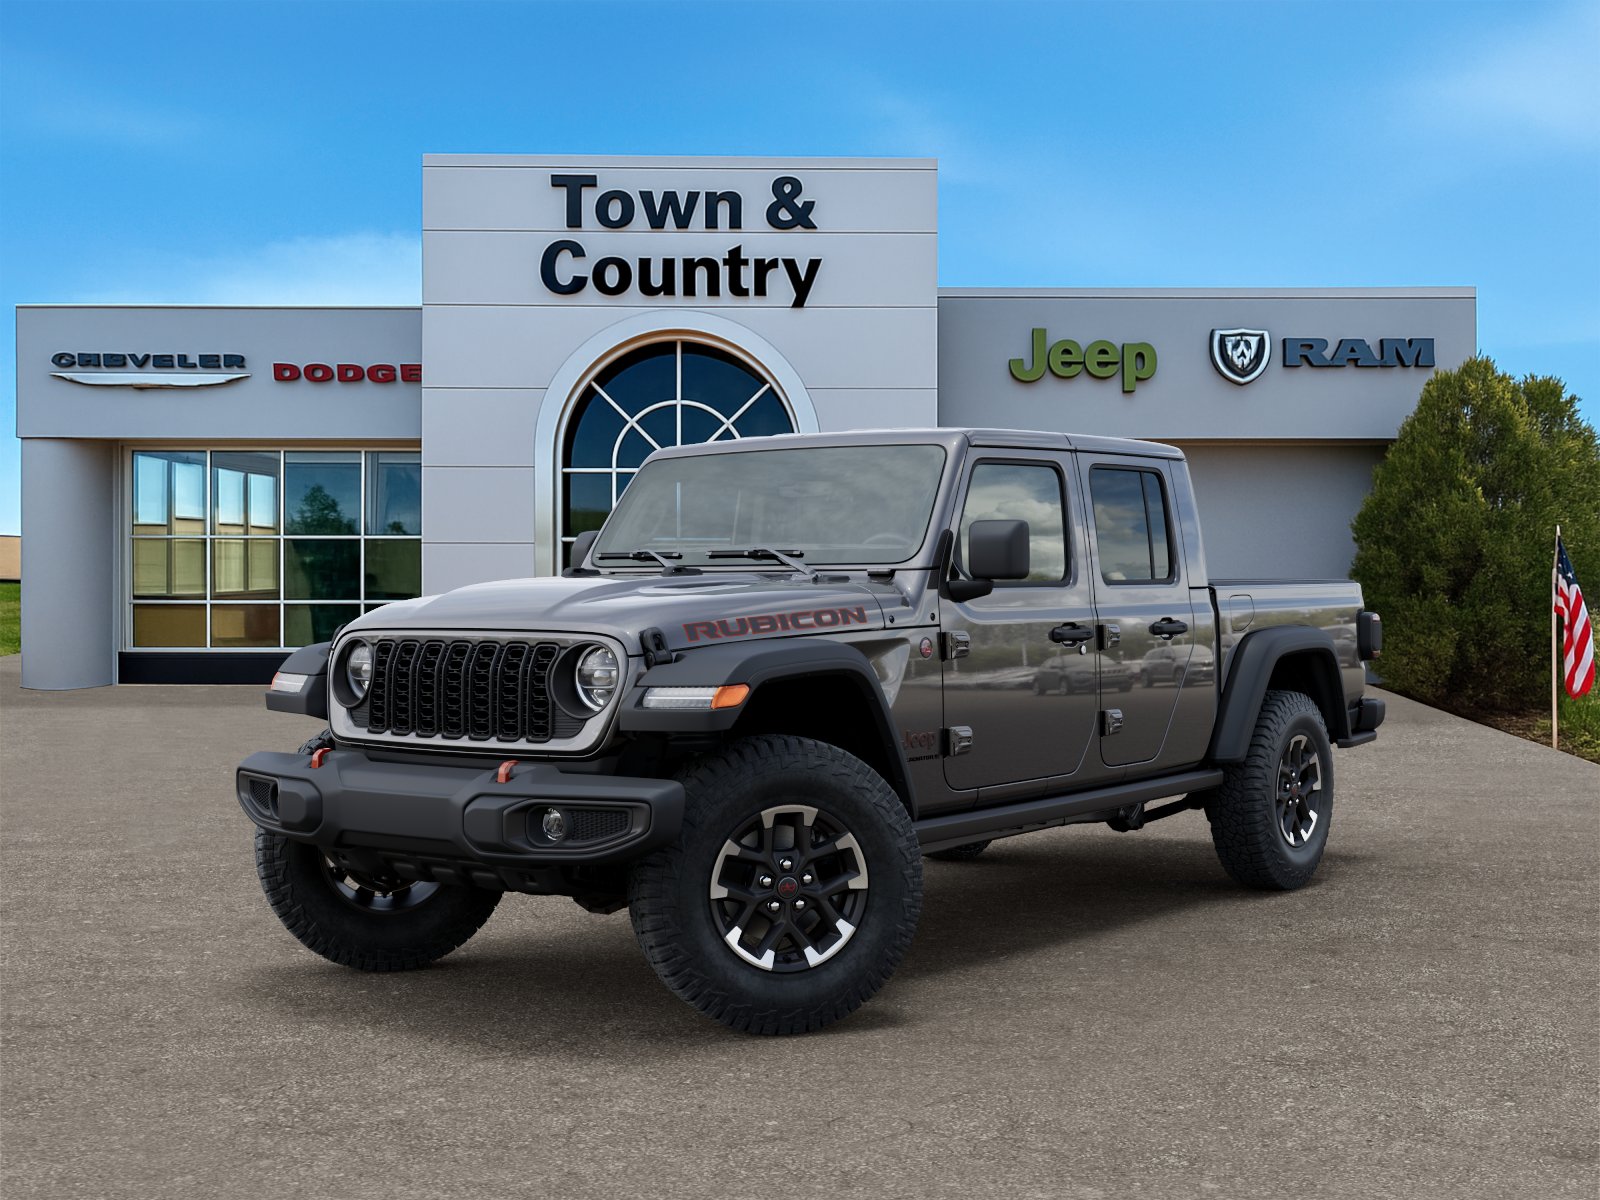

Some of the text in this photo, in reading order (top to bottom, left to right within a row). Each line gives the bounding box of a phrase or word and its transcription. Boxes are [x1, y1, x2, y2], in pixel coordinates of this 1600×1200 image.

[550, 174, 817, 230] Town &
[540, 239, 822, 308] Country
[273, 362, 422, 383] DODGE
[1009, 328, 1157, 393] Jeep
[1283, 337, 1436, 367] RAM
[683, 606, 868, 642] RUBICON
